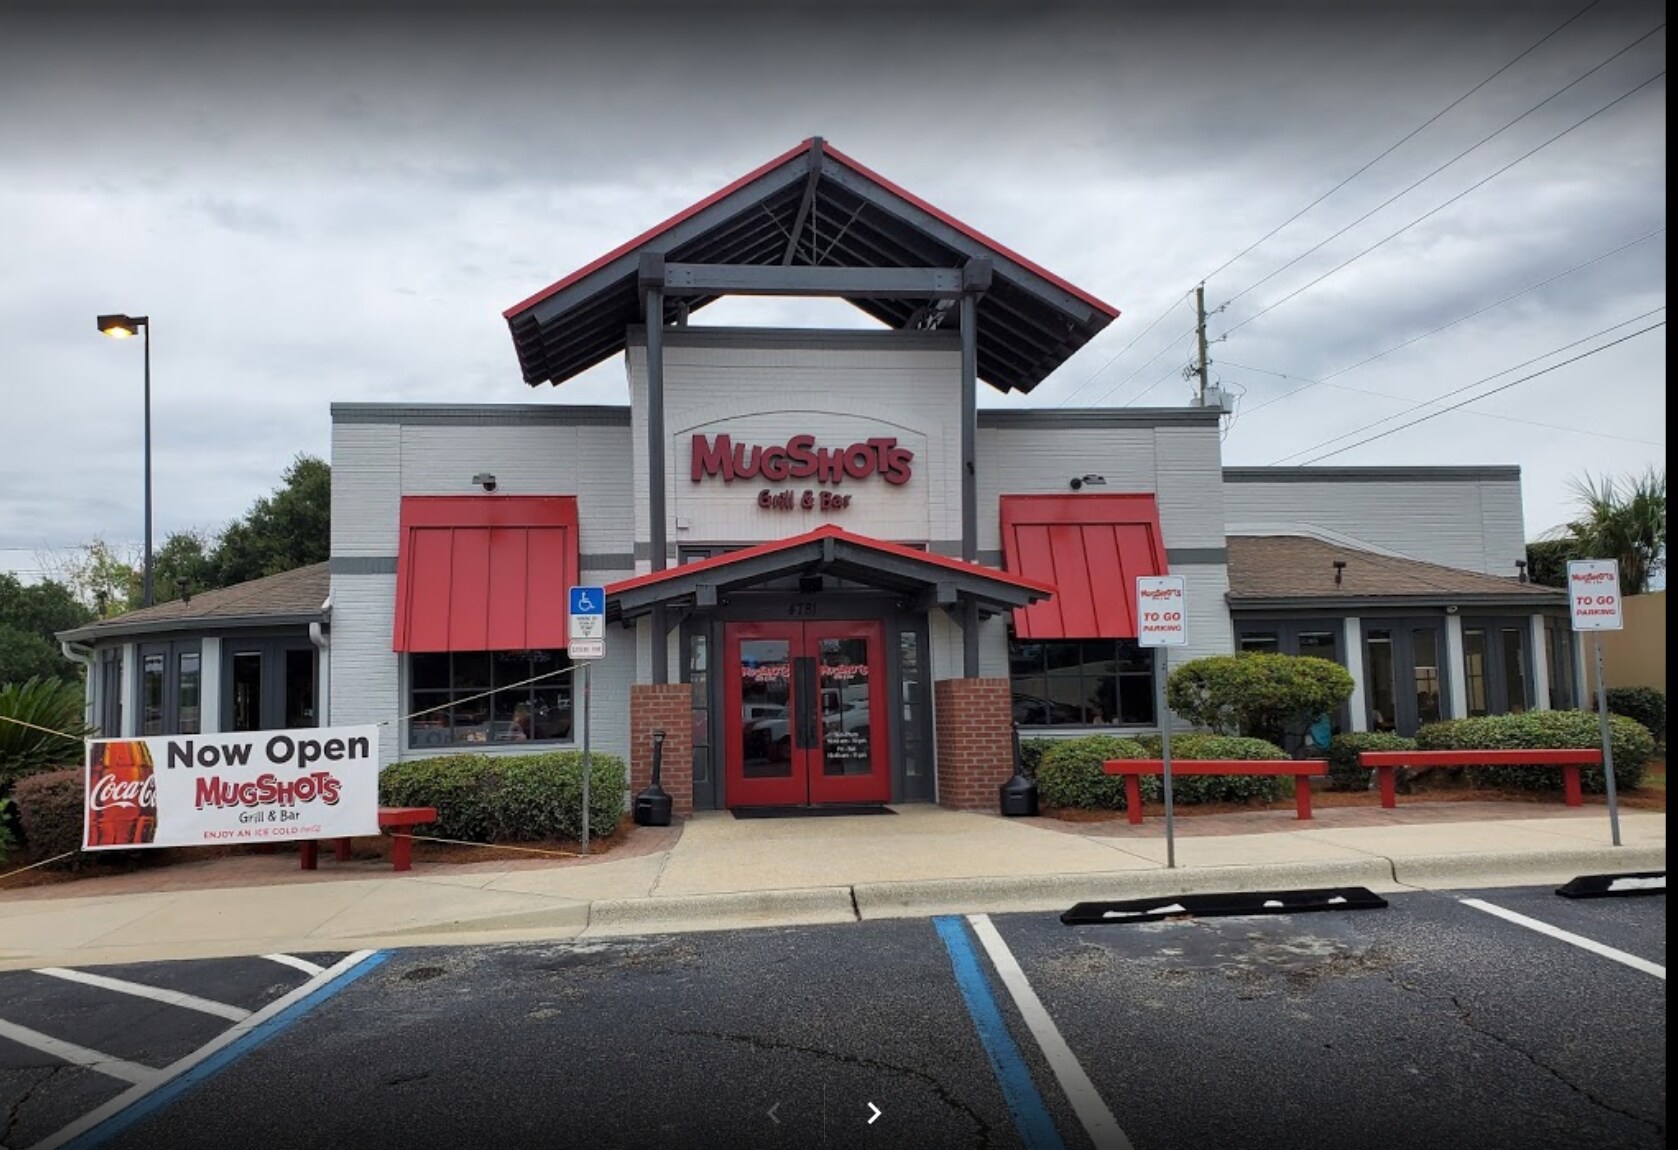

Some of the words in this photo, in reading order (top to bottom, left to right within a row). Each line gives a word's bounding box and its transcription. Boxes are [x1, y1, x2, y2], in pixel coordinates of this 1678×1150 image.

[757, 489, 794, 511] Grill
[800, 489, 815, 510] &
[819, 490, 852, 511] Bar
[1576, 595, 1593, 605] TO
[1596, 595, 1615, 605] GO
[1144, 612, 1160, 621] TO
[1163, 612, 1182, 621] GO
[1576, 608, 1616, 616] PARKING
[1143, 624, 1182, 632] PARKING
[167, 740, 253, 770] Now
[265, 735, 370, 769] Open
[239, 811, 264, 824] Grill
[268, 810, 277, 822] &
[280, 809, 301, 822] Bar
[203, 830, 234, 839] ENJOY
[237, 829, 251, 837] AN
[255, 827, 269, 836] ICE
[272, 826, 298, 835] COLD
